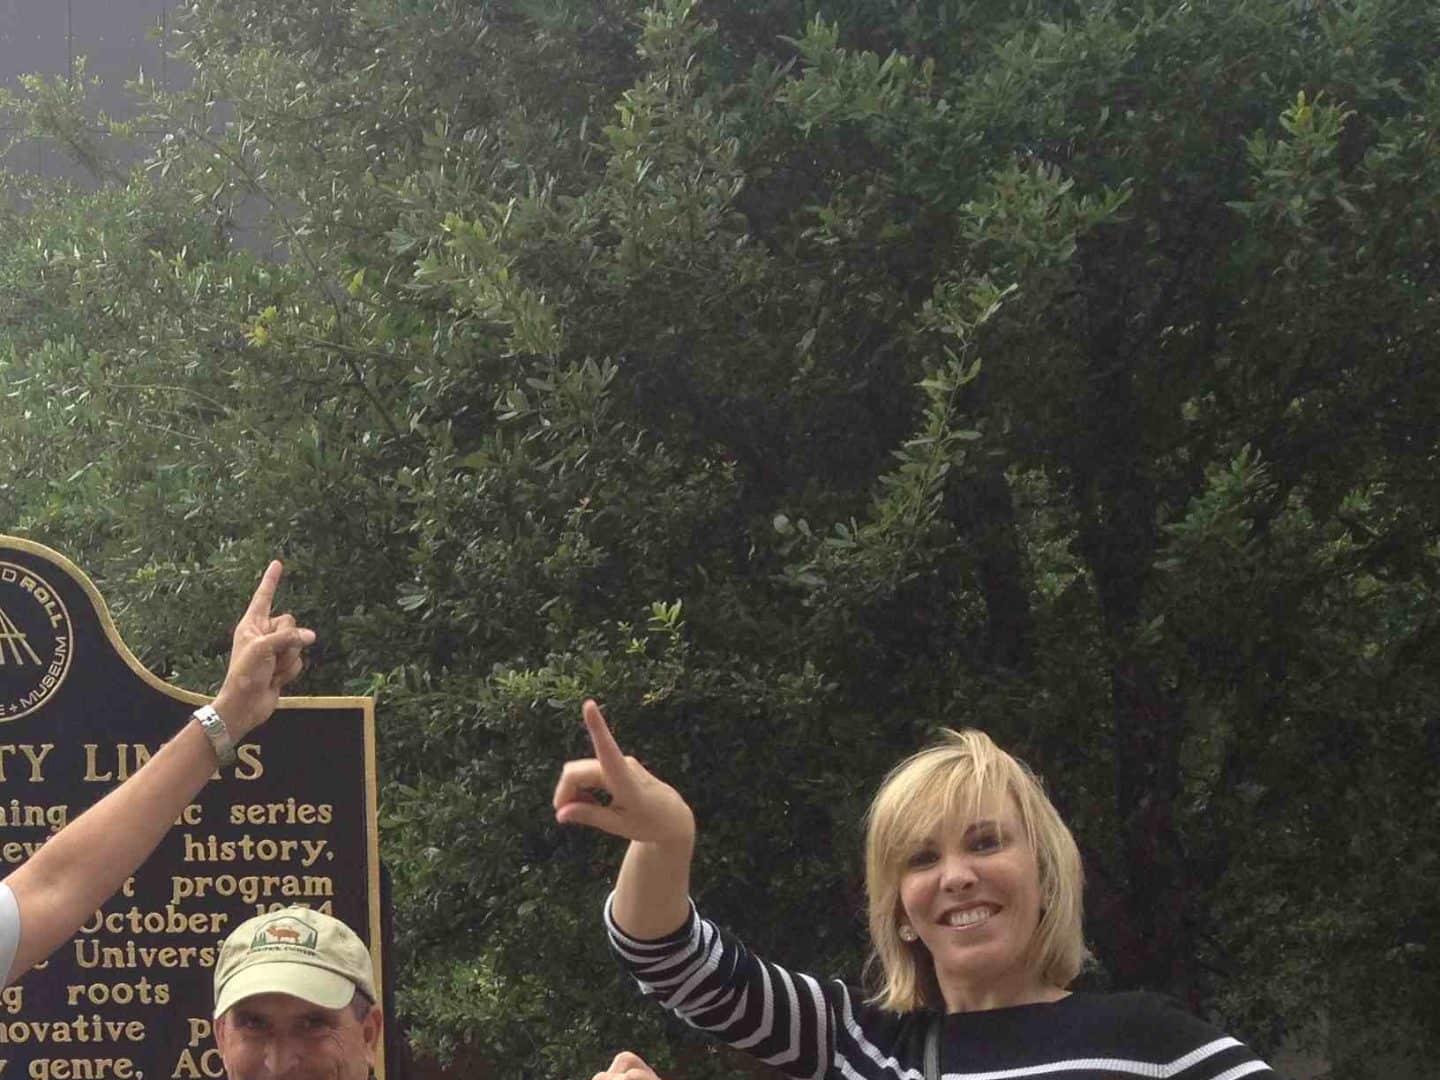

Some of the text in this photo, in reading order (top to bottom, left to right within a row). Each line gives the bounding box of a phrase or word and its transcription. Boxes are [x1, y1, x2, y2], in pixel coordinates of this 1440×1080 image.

[19, 575, 63, 628] ROLL
[19, 636, 67, 709] MUSEUM
[230, 797, 333, 825] series
[171, 874, 334, 906] program
[68, 976, 170, 1006] roots
[171, 1048, 224, 1079] AC
